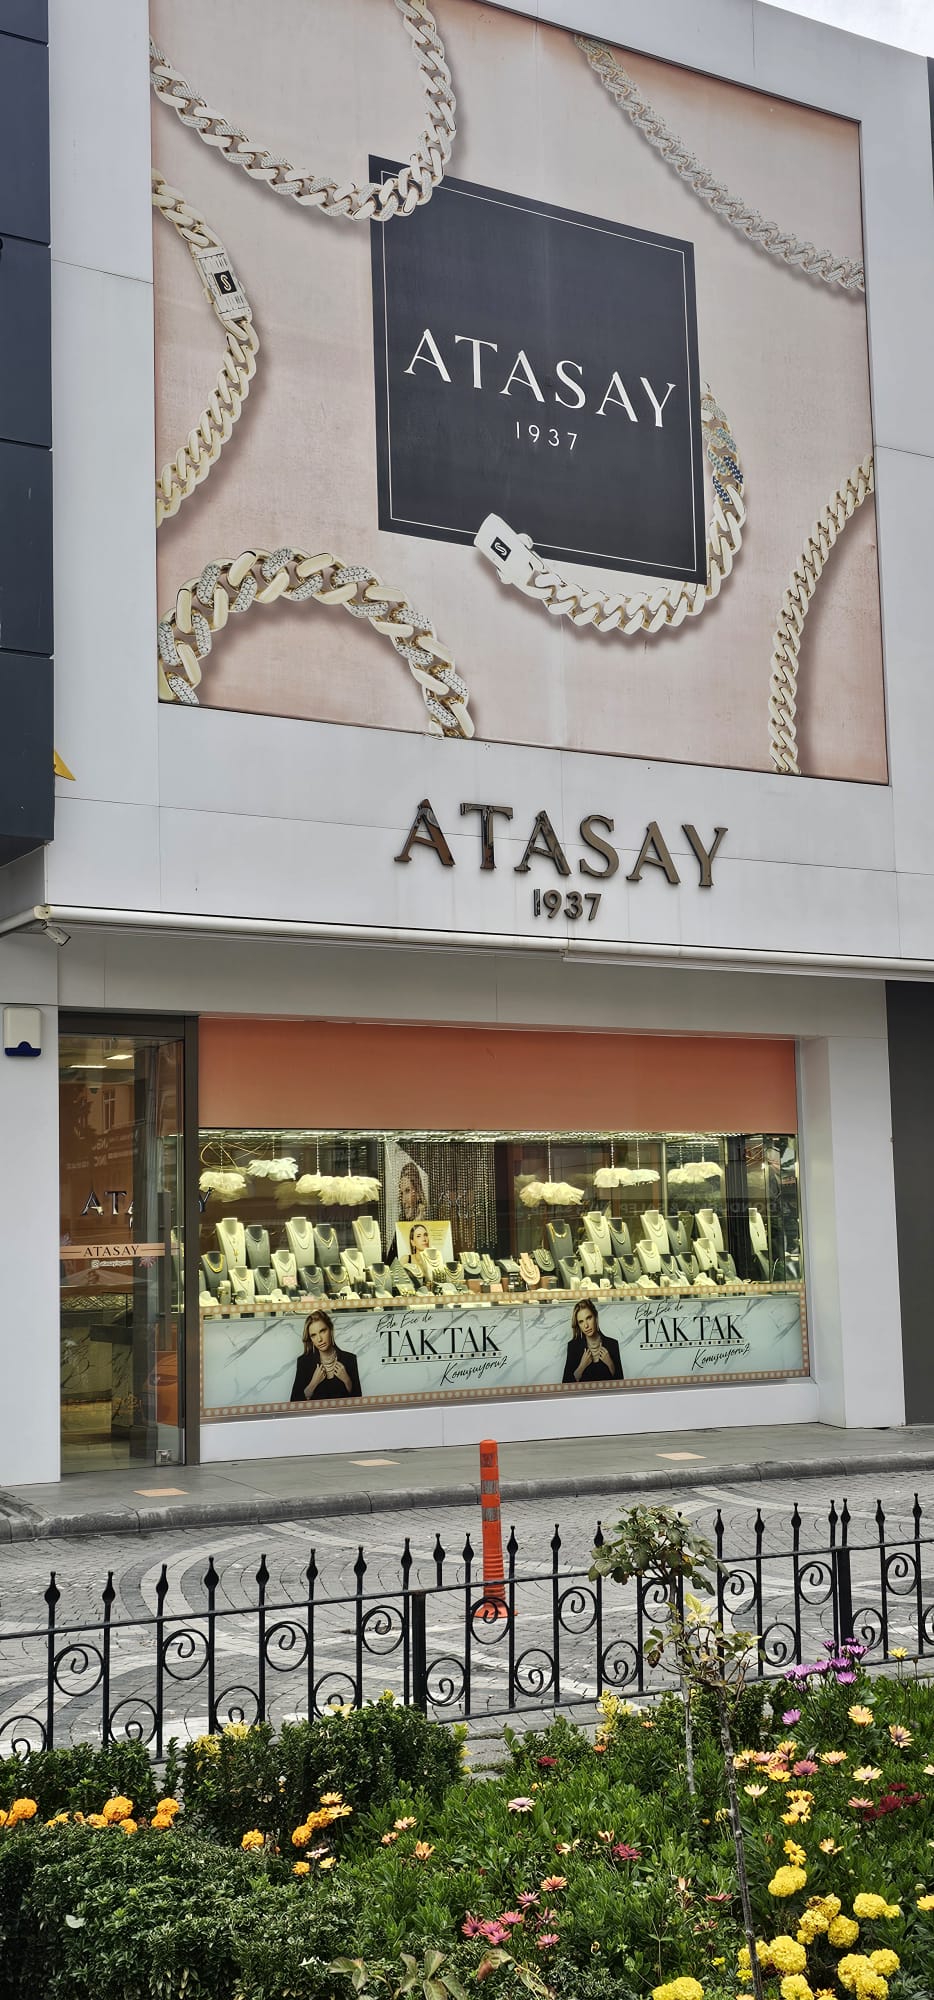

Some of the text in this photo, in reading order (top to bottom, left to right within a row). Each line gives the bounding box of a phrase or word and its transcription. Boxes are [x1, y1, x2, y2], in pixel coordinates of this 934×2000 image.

[403, 328, 677, 428] ATASAY
[515, 421, 577, 450] 1937
[394, 798, 729, 888] ATASAY
[533, 888, 602, 921] 1937
[83, 1245, 139, 1257] ATASAY
[379, 1325, 500, 1358] TAK TAK
[638, 1314, 743, 1343] TAK TAK
